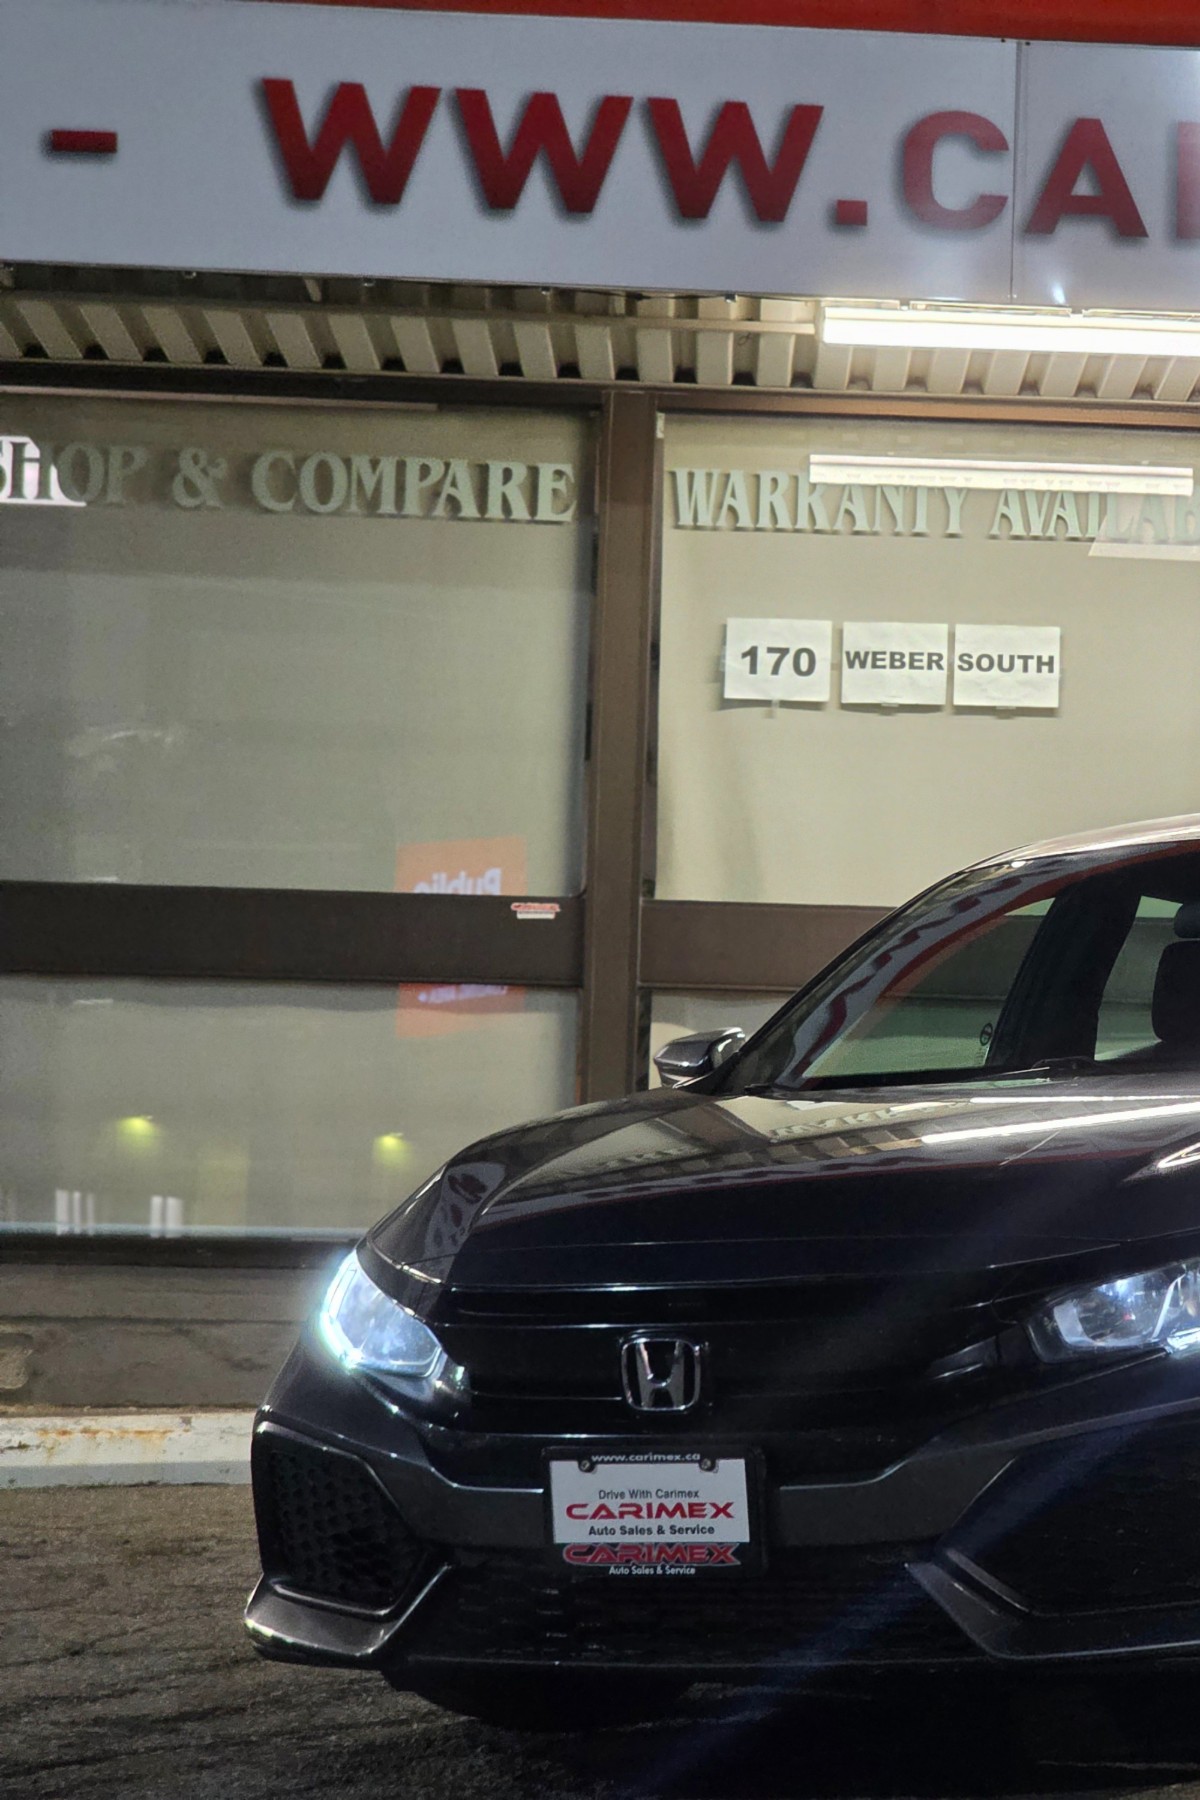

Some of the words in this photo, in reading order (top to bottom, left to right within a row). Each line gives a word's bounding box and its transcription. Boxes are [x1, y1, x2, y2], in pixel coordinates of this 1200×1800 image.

[172, 446, 225, 509] &
[252, 450, 575, 524] COMPARE
[670, 468, 970, 537] WARRANTY
[741, 645, 816, 677] 170
[845, 650, 945, 672] WEBER
[957, 652, 1055, 674] SOUTH
[591, 1452, 701, 1462] www.carimex.ca
[598, 1489, 625, 1500] Drive
[628, 1489, 652, 1499] With
[655, 1488, 700, 1499] Carimex
[566, 1502, 735, 1520] CARIMEX
[589, 1525, 616, 1536] Auto
[620, 1525, 653, 1536] Sales
[656, 1525, 665, 1535] &
[669, 1524, 715, 1535] Service
[563, 1543, 740, 1565] CARIMEX
[609, 1566, 630, 1575] Auto
[631, 1565, 654, 1575] Sales
[656, 1566, 663, 1575] &
[665, 1565, 696, 1575] Service
